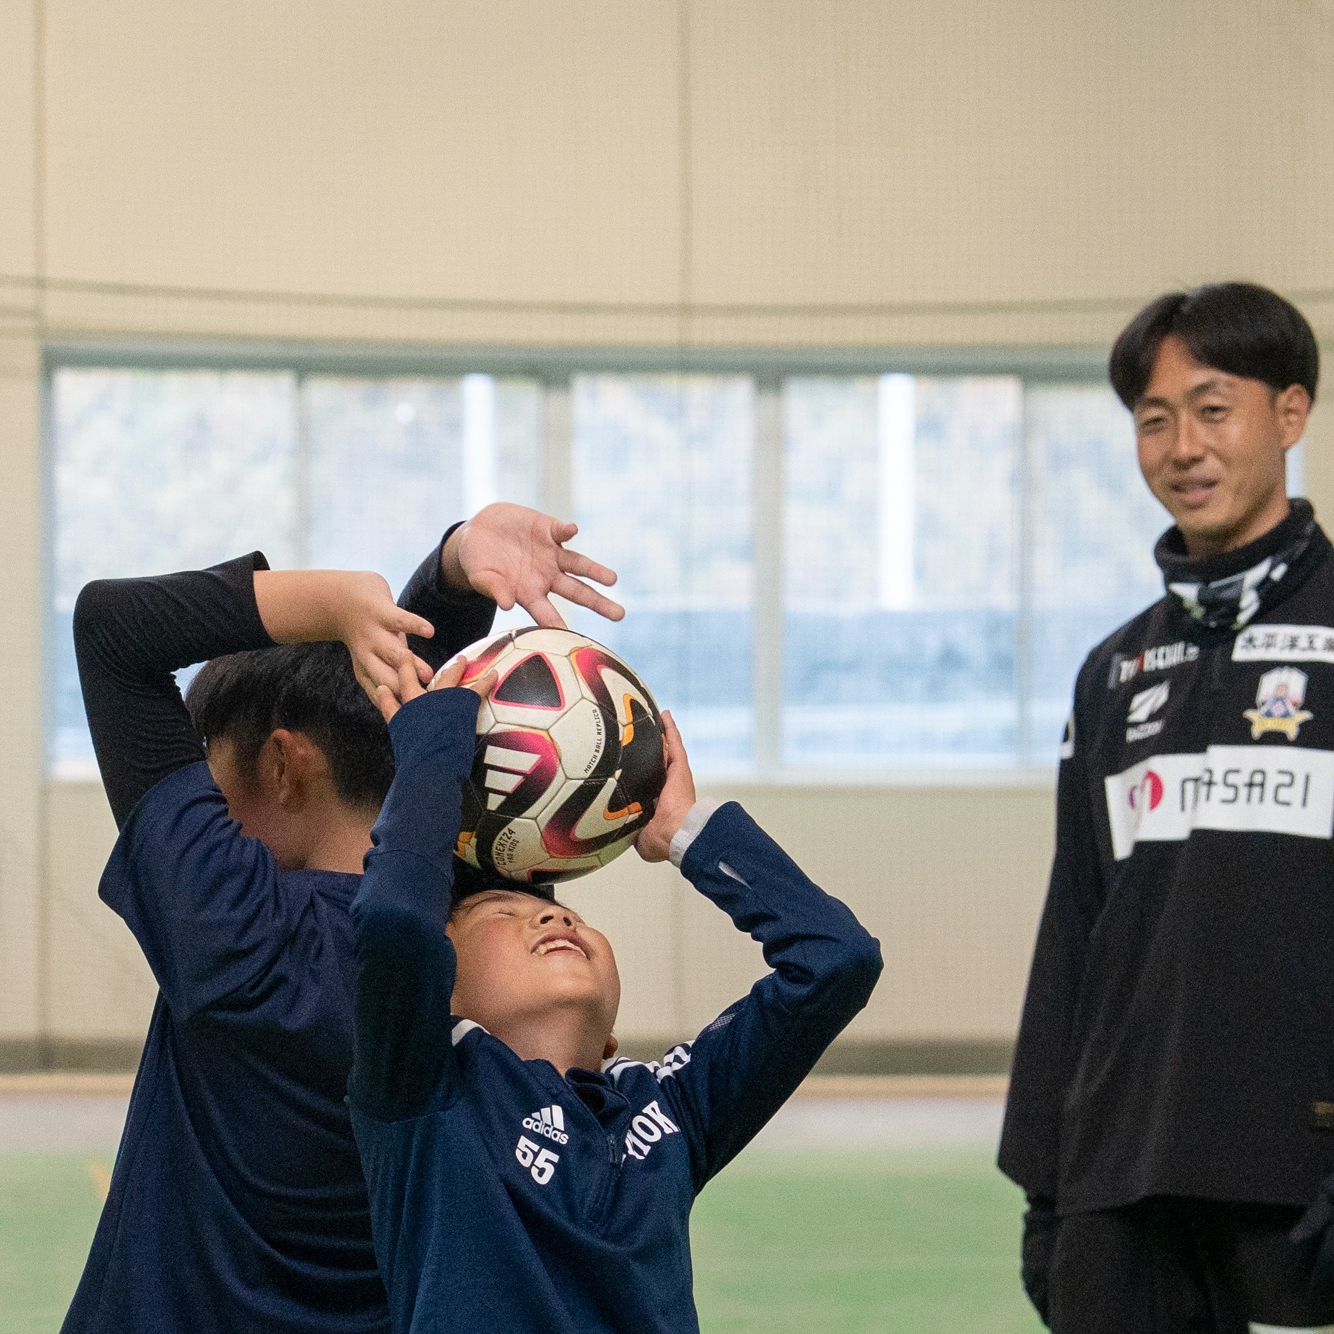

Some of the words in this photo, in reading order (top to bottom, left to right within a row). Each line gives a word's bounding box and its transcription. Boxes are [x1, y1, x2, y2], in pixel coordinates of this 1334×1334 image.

[583, 755, 598, 774] MATCH
[592, 709, 602, 736] REPLICA
[522, 1116, 569, 1145] adidas
[515, 1135, 560, 1185] 55
